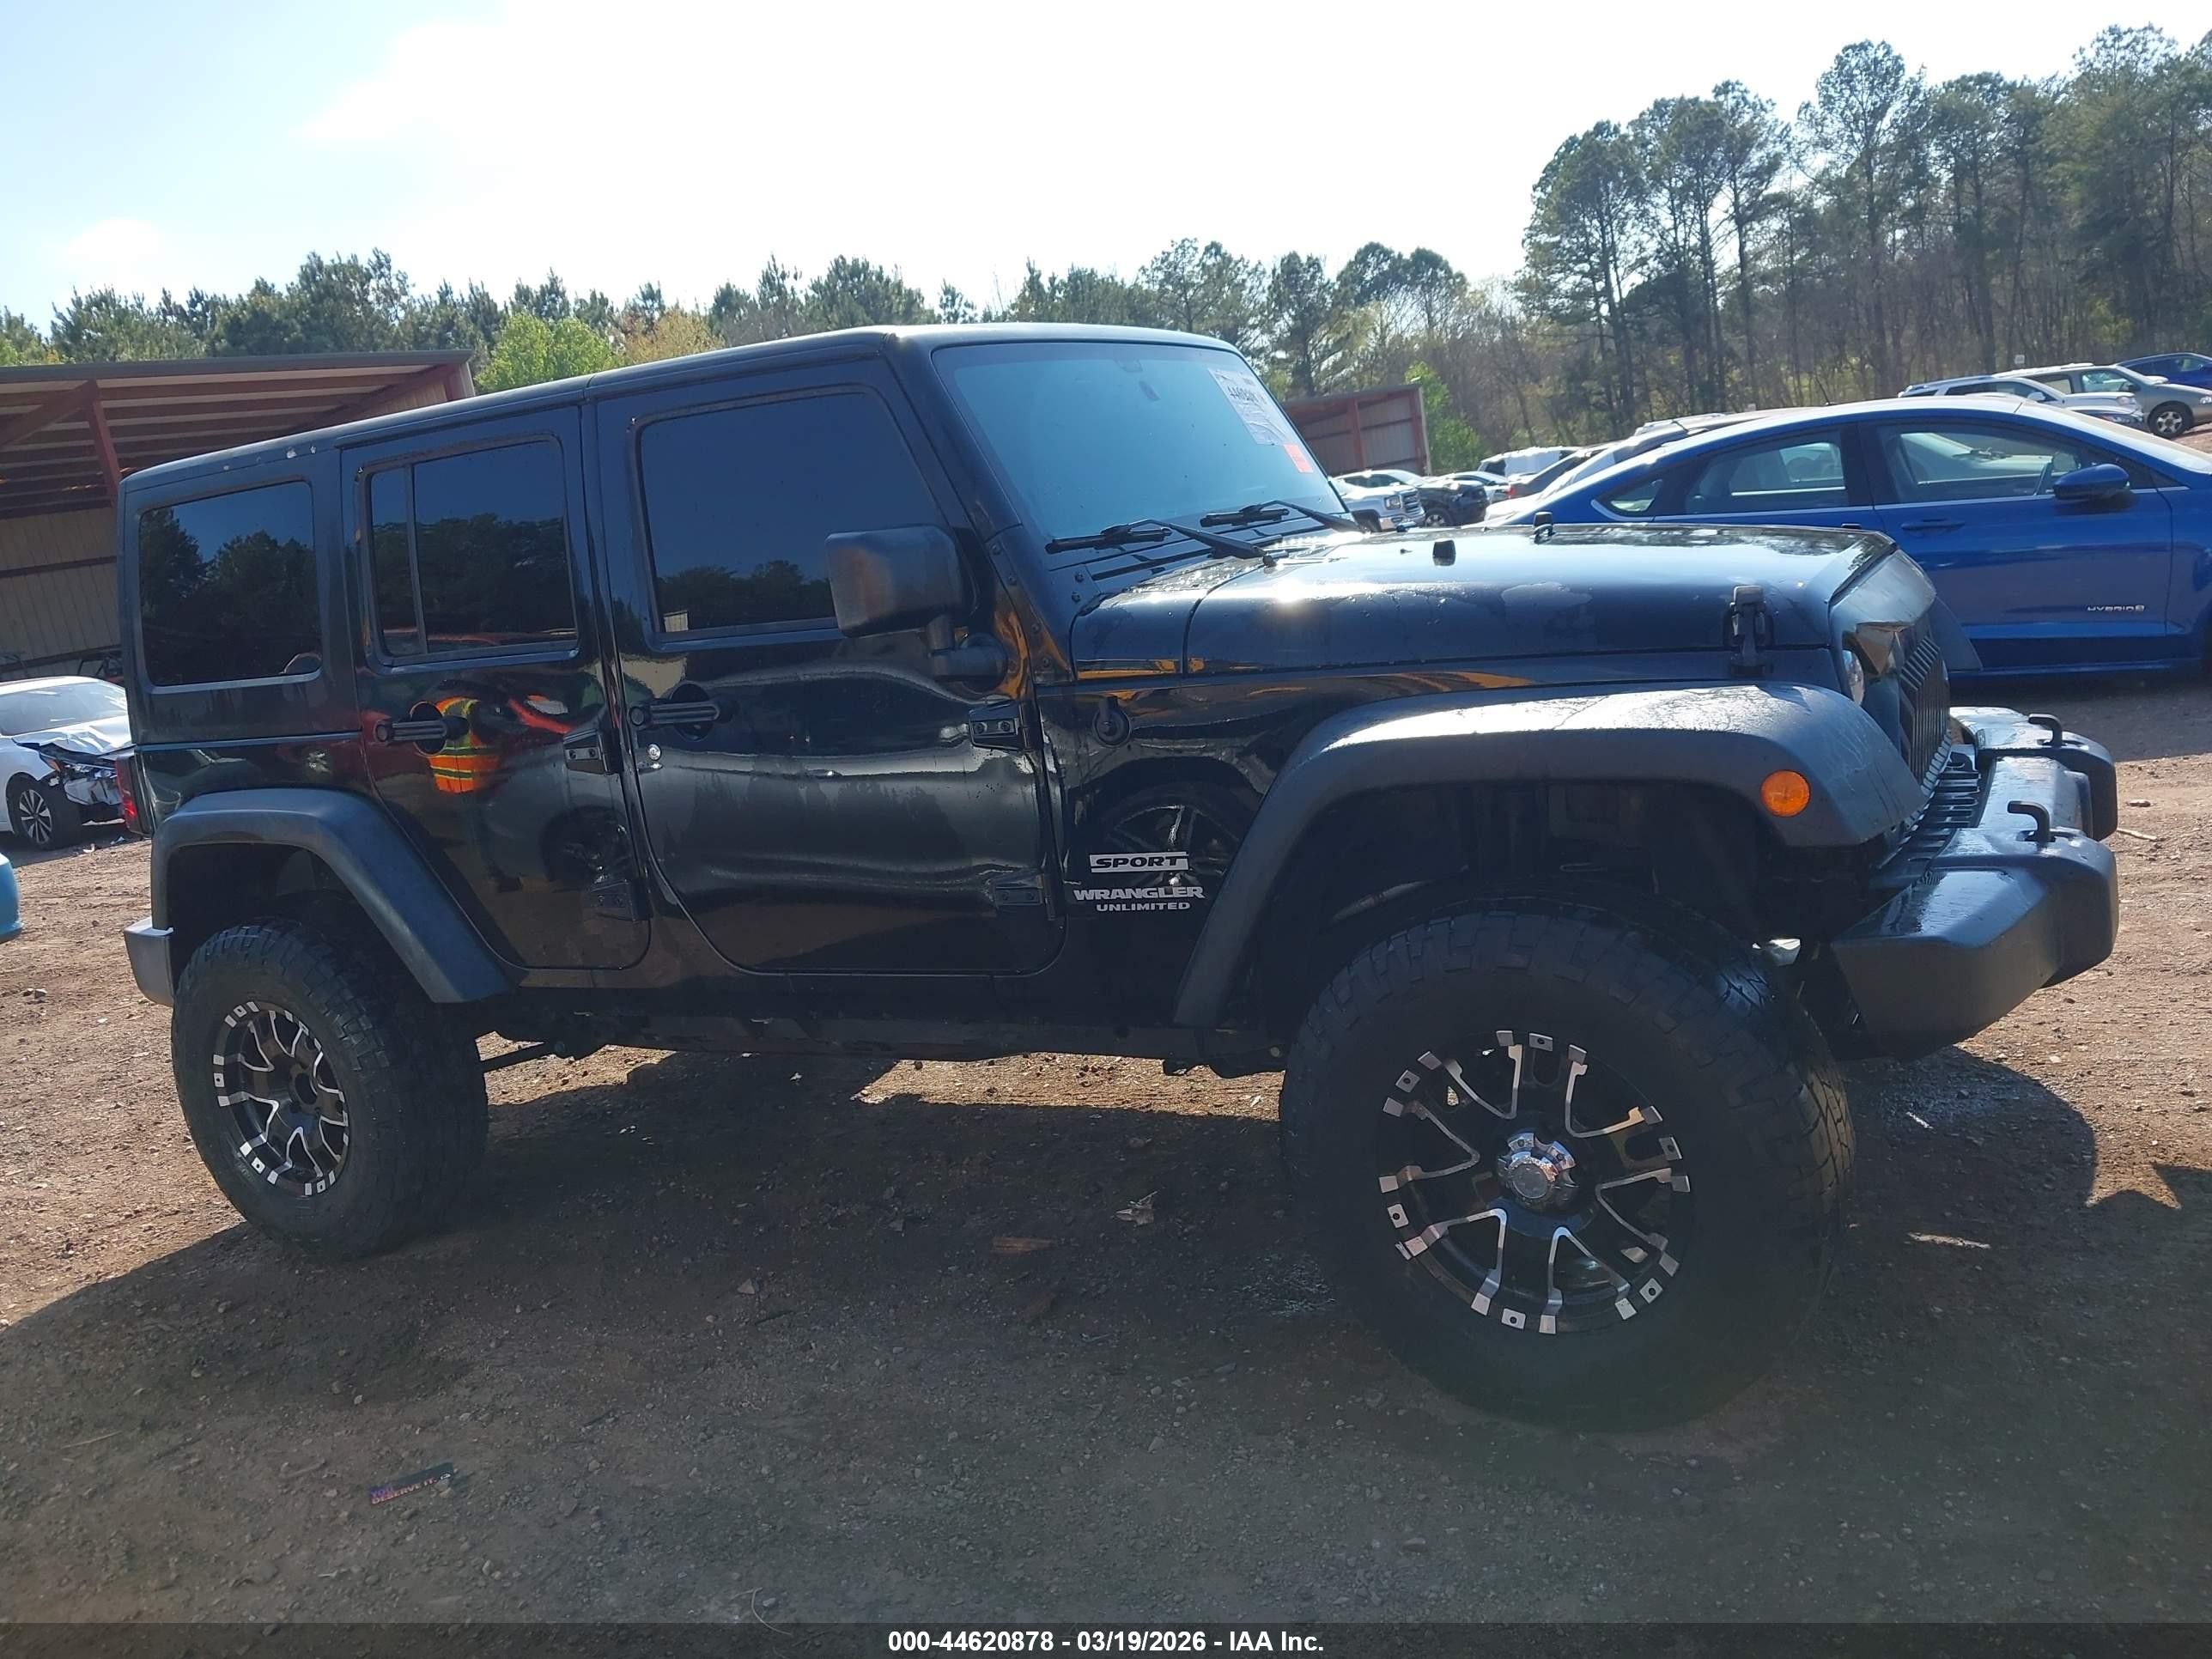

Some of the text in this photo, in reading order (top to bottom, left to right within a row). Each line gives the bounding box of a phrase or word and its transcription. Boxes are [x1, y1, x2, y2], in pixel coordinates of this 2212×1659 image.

[1091, 855, 1189, 870] SPORT
[1073, 886, 1206, 901] WRANGLER
[1096, 902, 1191, 912] UNLIMITED
